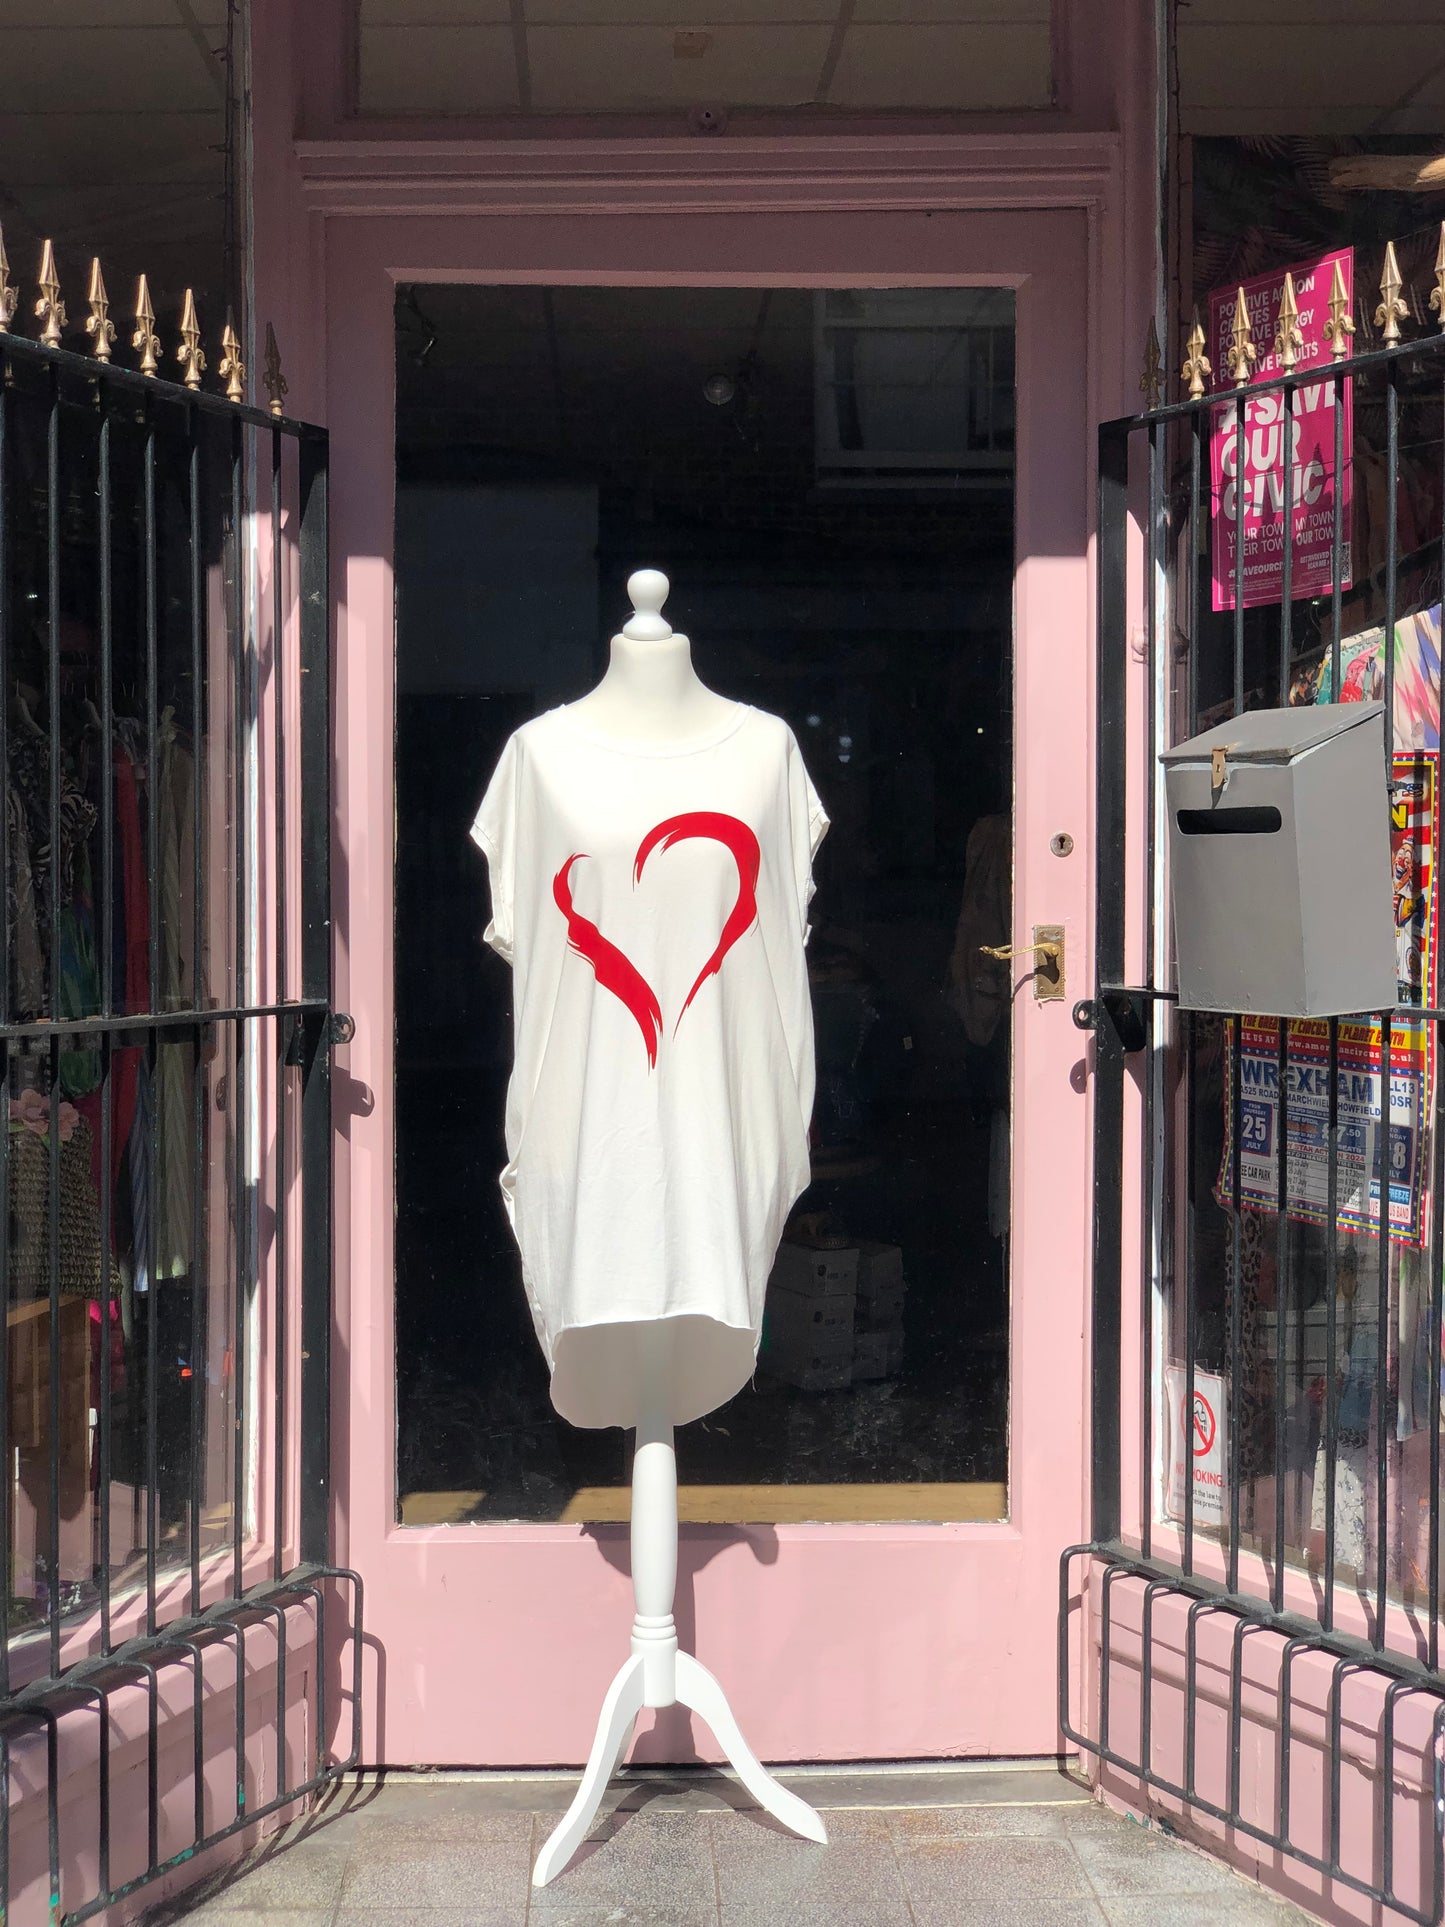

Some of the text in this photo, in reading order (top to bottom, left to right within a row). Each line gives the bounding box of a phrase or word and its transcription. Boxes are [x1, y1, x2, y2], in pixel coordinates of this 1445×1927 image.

[1221, 420, 1302, 477] OUR
[1223, 460, 1324, 521] CIVIC
[1261, 521, 1285, 538] TOW
[1295, 515, 1307, 531] MY
[1296, 526, 1335, 546] OUR TOW
[1227, 537, 1285, 558] TEIR TOW
[1253, 1033, 1263, 1042] US
[1265, 1035, 1276, 1044] AT
[1337, 1102, 1381, 1116] HOWFIELD
[1242, 1114, 1267, 1141] 25
[1245, 1140, 1262, 1150] JULY
[1389, 1132, 1407, 1141] NDAY
